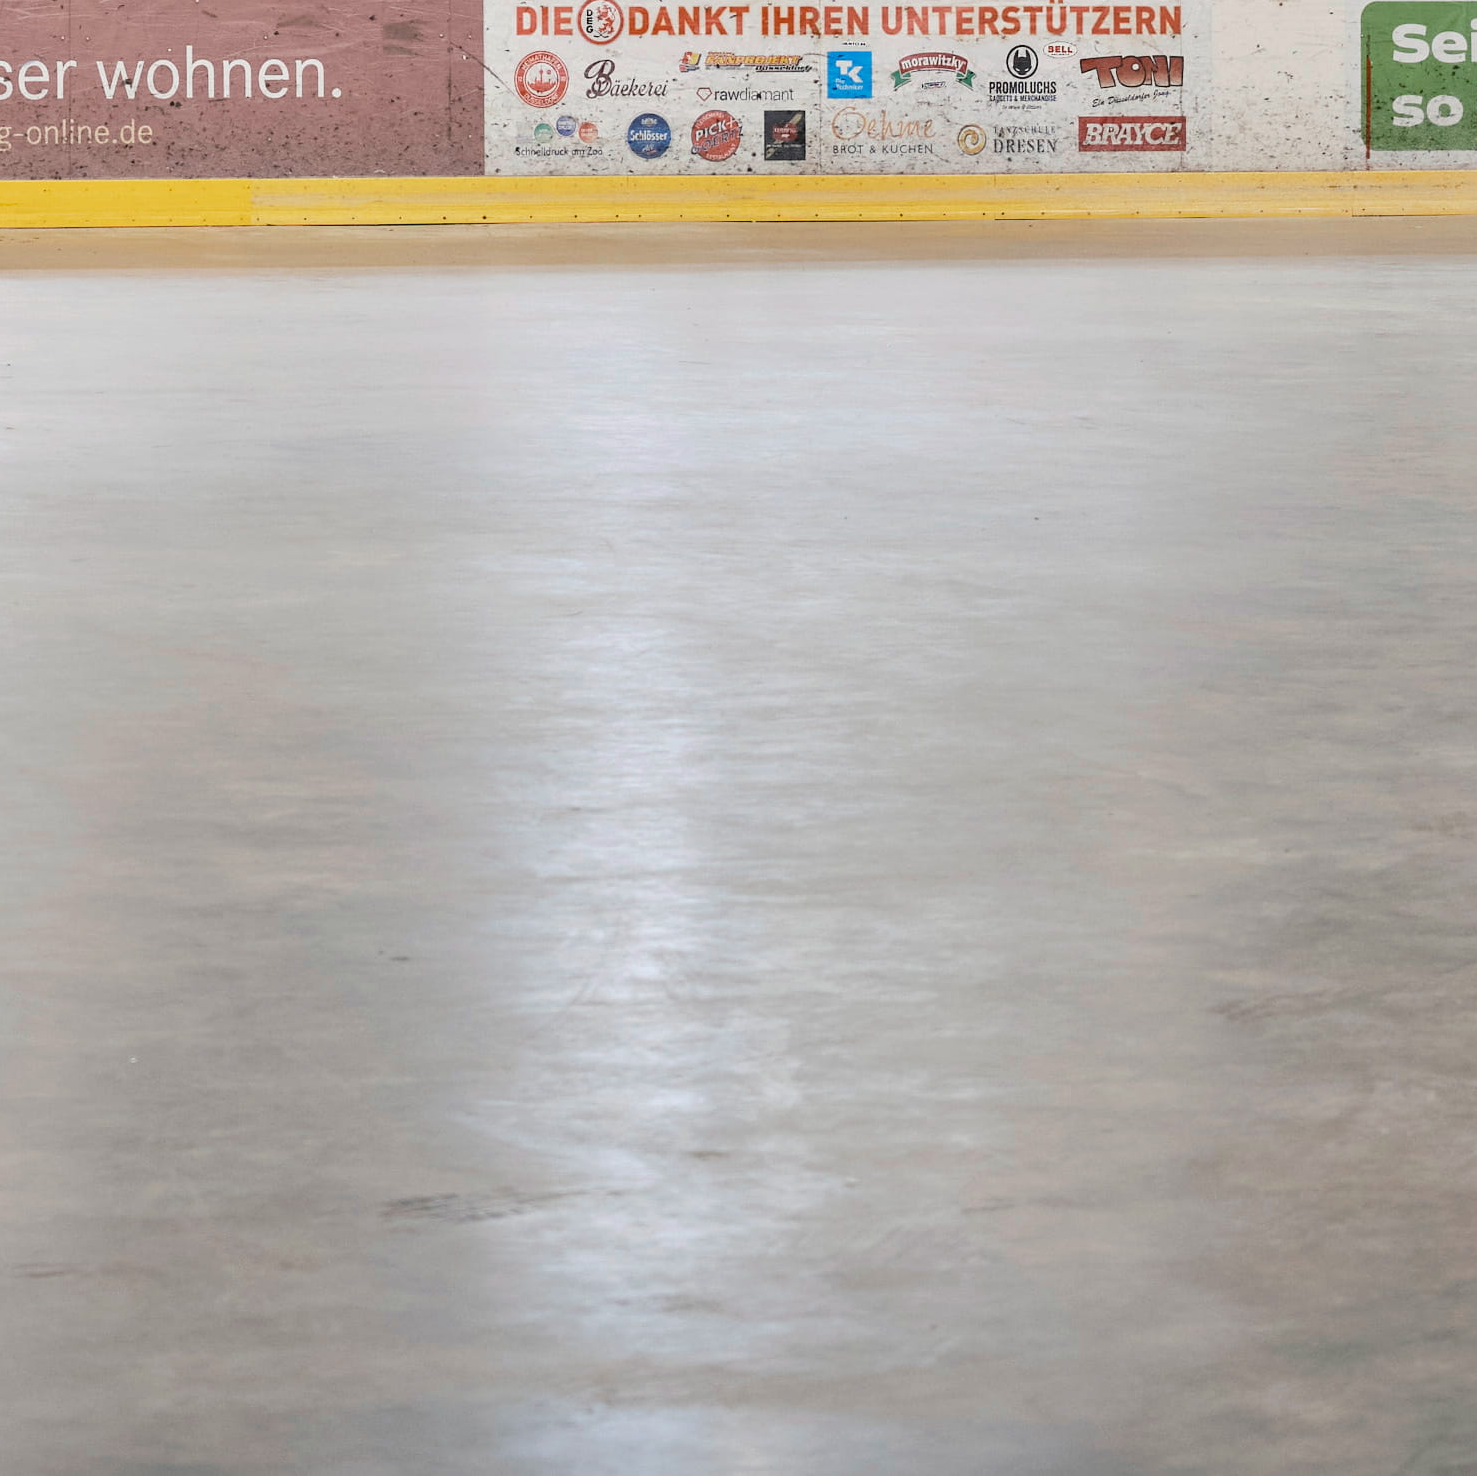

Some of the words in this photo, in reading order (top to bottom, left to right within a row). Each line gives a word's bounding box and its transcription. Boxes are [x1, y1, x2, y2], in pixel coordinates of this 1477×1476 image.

[516, 6, 573, 35] DIE
[628, 6, 749, 36] DANKT
[761, 6, 868, 36] IHREN
[97, 45, 342, 100] wohnen.
[901, 55, 965, 72] morawitzky
[1080, 55, 1184, 88] TONI
[989, 82, 1056, 94] PROMOLUCHS
[1391, 91, 1464, 127] so
[630, 130, 667, 142] Schlösser
[1082, 123, 1183, 145] BRAYCE
[832, 145, 863, 154] BROT
[869, 145, 876, 154] &
[882, 144, 934, 154] KUCHEN
[993, 139, 1057, 153] DRESEN
